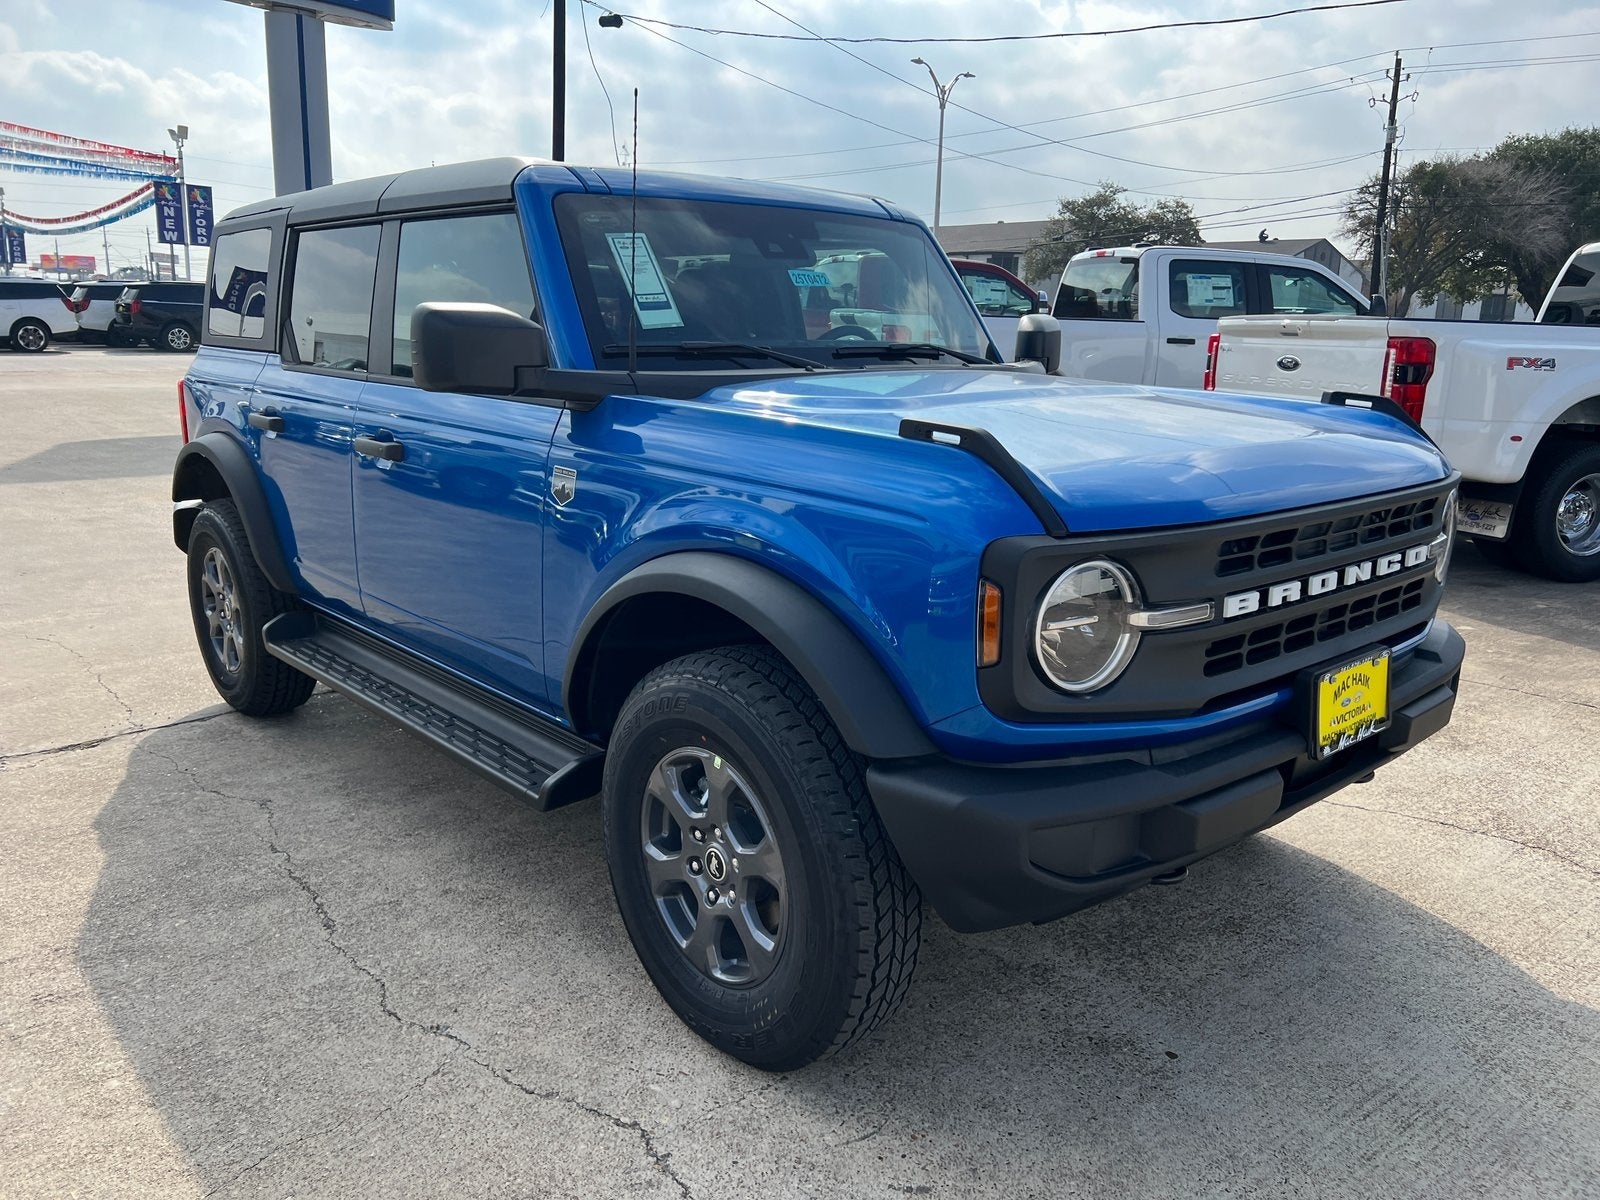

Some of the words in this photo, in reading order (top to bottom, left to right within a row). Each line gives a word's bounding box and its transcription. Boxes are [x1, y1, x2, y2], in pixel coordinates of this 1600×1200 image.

[163, 205, 178, 241] NEW
[195, 209, 208, 244] FORD
[791, 273, 830, 285] 25T0472
[1506, 356, 1556, 370] FX4
[1222, 374, 1293, 389] SUPER
[1299, 379, 1370, 393] DUTY
[1223, 545, 1429, 618] BRONCO
[1333, 675, 1351, 704] MAC
[1352, 672, 1370, 690] HAIK
[1336, 703, 1367, 725] VICTORIA
